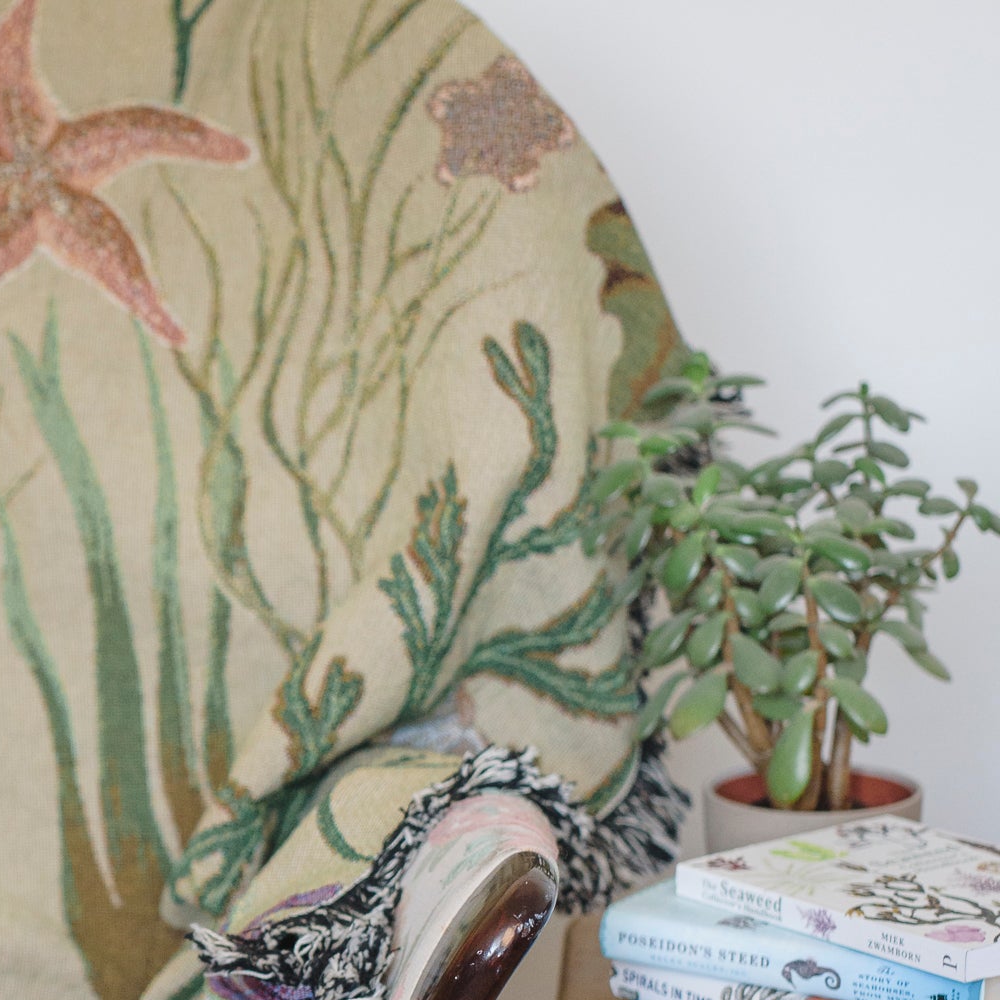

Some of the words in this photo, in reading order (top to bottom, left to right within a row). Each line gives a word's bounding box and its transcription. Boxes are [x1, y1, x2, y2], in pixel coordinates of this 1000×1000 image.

[720, 879, 782, 912] Seaweed
[618, 931, 712, 958] POSEIDON'S
[718, 949, 770, 968] STEED
[881, 932, 905, 947] MIEK
[868, 940, 921, 963] ZWAMBORN
[622, 968, 667, 996] SPIRALS
[671, 986, 683, 1000] IN
[859, 974, 890, 984] STORY
[897, 980, 910, 988] OF
[853, 990, 881, 1000] FROM
